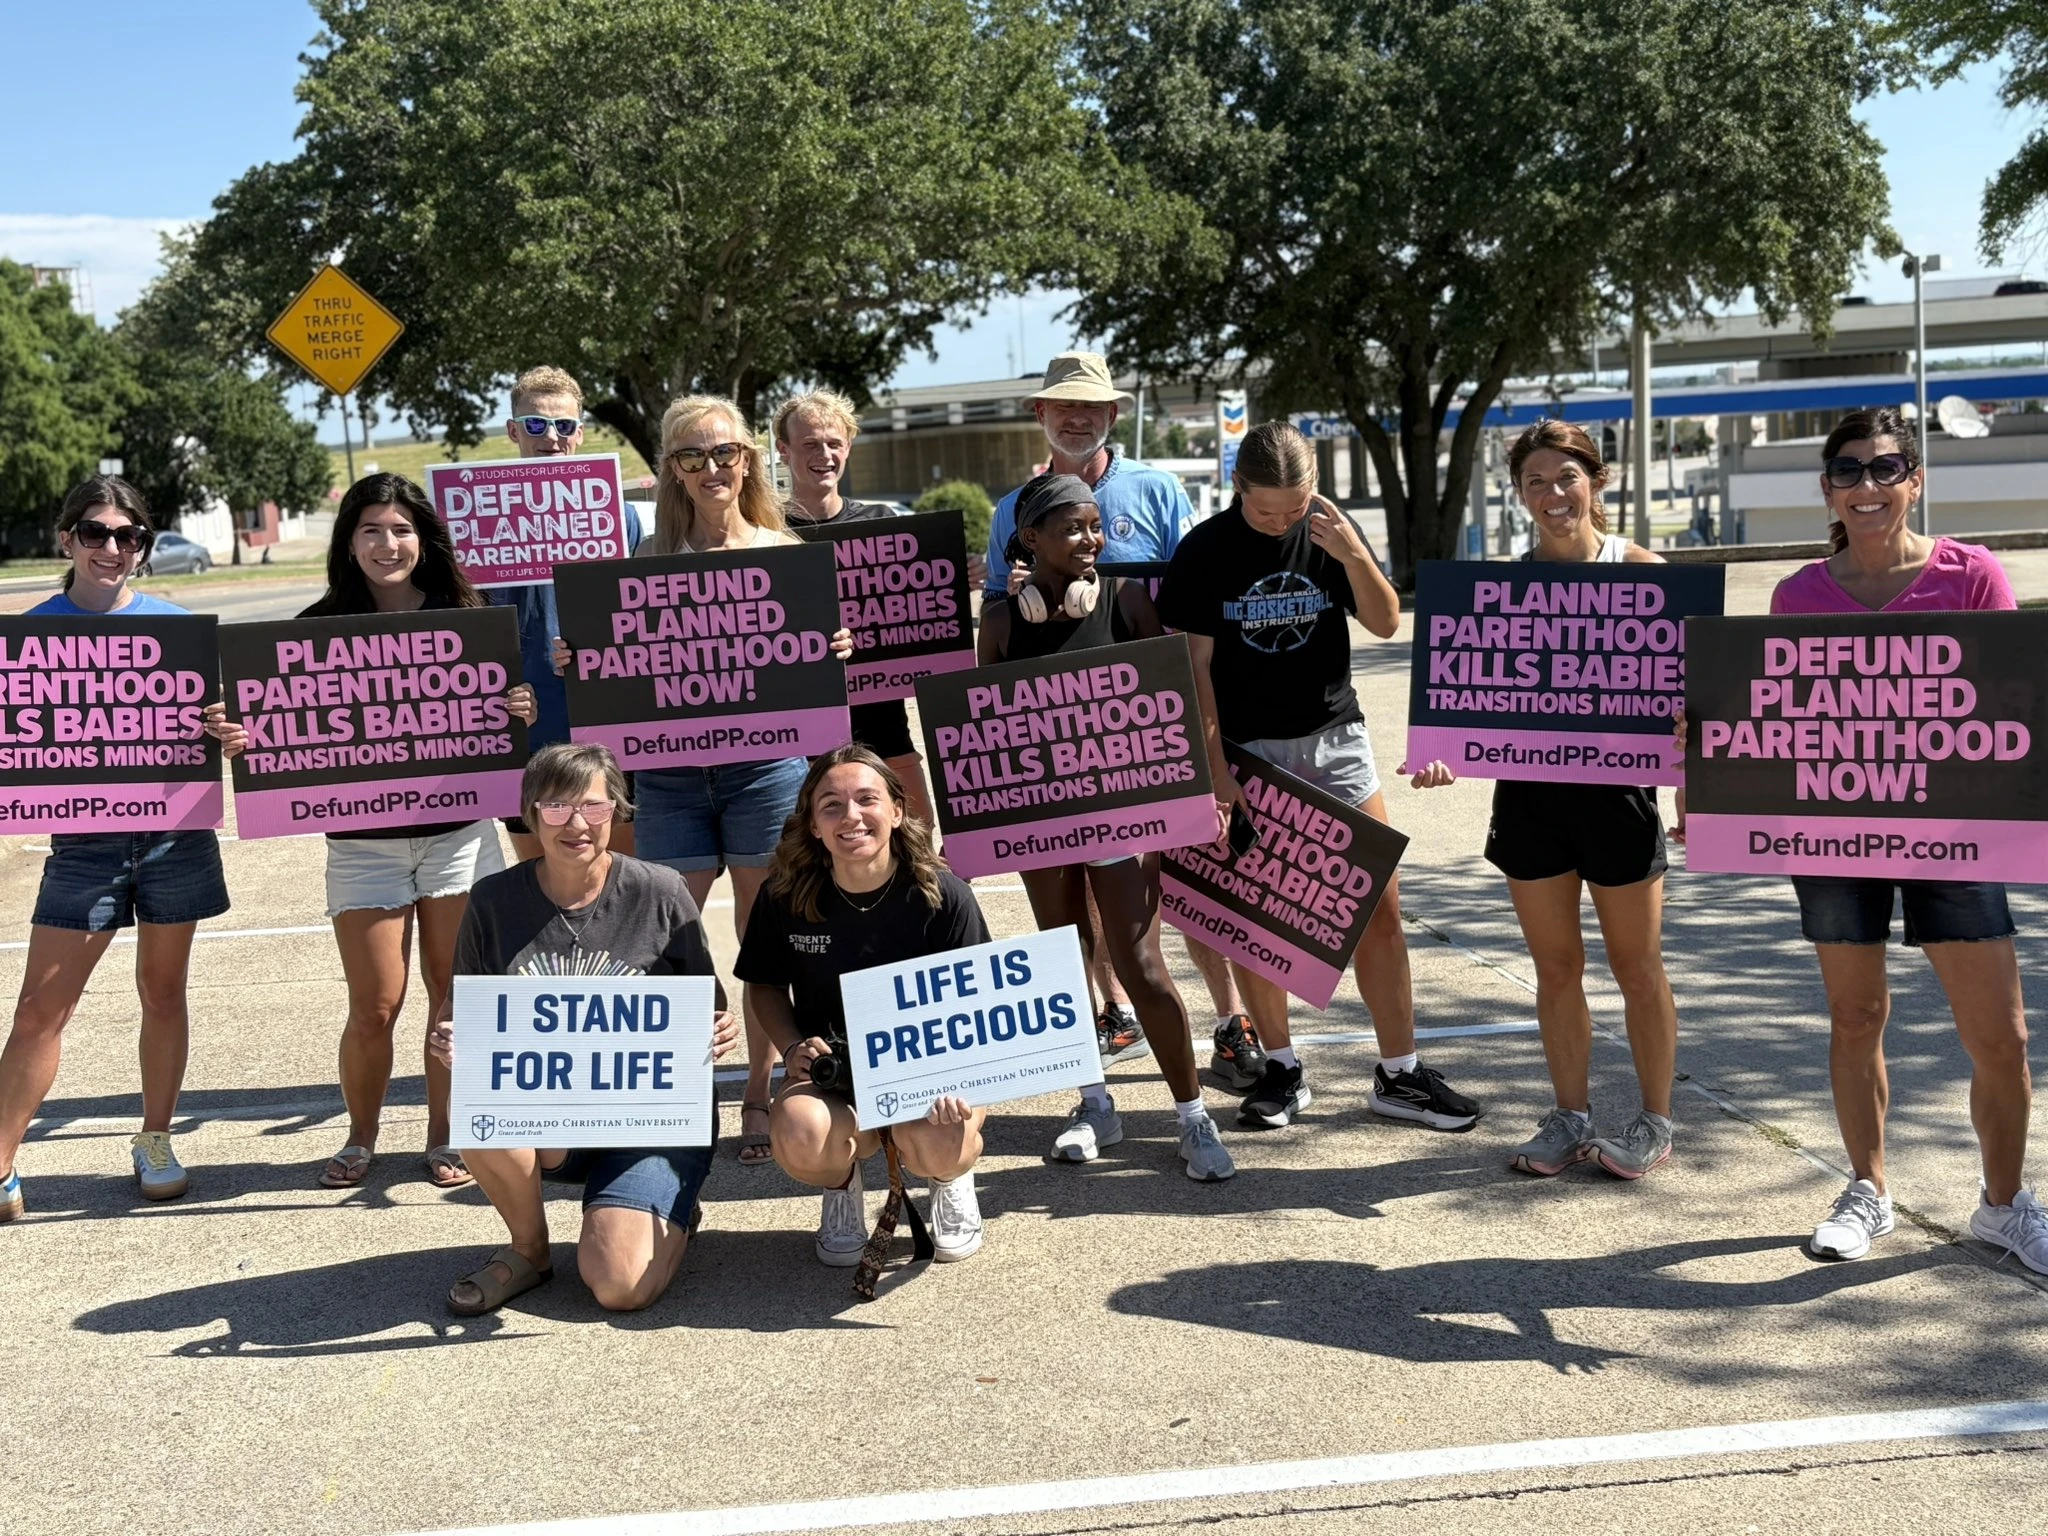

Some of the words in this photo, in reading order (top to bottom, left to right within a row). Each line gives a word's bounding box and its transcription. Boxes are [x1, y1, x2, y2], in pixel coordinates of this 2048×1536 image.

[304, 313, 365, 327] TRAFFIC
[313, 297, 352, 310] THRU
[307, 330, 364, 344] MERGE
[313, 347, 362, 360] RIGHT
[475, 464, 591, 480] STUDENTSFORLIFE.ORG
[444, 478, 612, 519] DEFUND
[448, 511, 615, 547] PLANNED
[455, 539, 617, 567] PARENTHOOD
[834, 532, 919, 568] NNED
[496, 569, 514, 578] TEXT
[517, 568, 534, 577] LIFE
[535, 567, 547, 575] TO
[619, 567, 772, 610] DEFUND
[837, 558, 955, 598] THOOD
[839, 588, 957, 629] BABIES
[1474, 581, 1665, 616] PLANNED
[612, 600, 786, 644] PLANNED
[880, 620, 960, 647] MINORS
[1242, 612, 1319, 630] INSTRUCTION
[1429, 615, 1685, 653] PARENTHOO
[0, 636, 162, 670] LANNED
[276, 630, 463, 674] PLANNED
[577, 630, 827, 681] PARENTHOOD
[1429, 651, 1541, 687] KILLS
[1551, 655, 1685, 691] BABIE
[1764, 635, 1962, 676] DEFUND
[0, 670, 206, 705] ENTHOOD
[236, 662, 507, 712] PARENTHOOD
[654, 669, 757, 708] NOW!
[847, 670, 932, 693] dPP.co
[967, 662, 1140, 719] PLANNED
[1750, 677, 1977, 718] PLANNED
[242, 708, 355, 750] KILLS
[363, 696, 510, 740] BABIES
[1426, 689, 1594, 716] TRANSITIONS
[1600, 695, 1685, 718] MINO
[54, 706, 205, 743] BABIES
[624, 727, 799, 756] DefundPP.com
[935, 690, 1185, 758] PARENTHOOD
[1701, 720, 2031, 762] PARENTHOOD
[0, 746, 99, 769] SITIONS
[105, 744, 207, 767] MINORS
[244, 741, 410, 775] TRANSITIONS
[414, 733, 513, 761] MINORS
[943, 748, 1045, 793] KILLS
[1050, 724, 1190, 777] BABIES
[1465, 741, 1660, 770] DefundPP.com
[947, 776, 1097, 817] TRANSITIONS
[1101, 760, 1196, 793] MINORS
[1796, 762, 1928, 803] NOW!
[0, 797, 167, 820] efundPP.com
[291, 790, 478, 821] DefundPP.com
[1229, 764, 1353, 851] ANNED
[993, 818, 1167, 859] DefundPP.com
[1247, 806, 1373, 898] THOOD
[1749, 831, 1978, 861] DefundPP.com
[1160, 848, 1262, 906] NSITIONS
[1261, 893, 1347, 951] MINORS
[1234, 847, 1359, 929] BABIES
[806, 944, 828, 953] LIFE
[1160, 885, 1292, 975] efundPP.com
[893, 959, 977, 1011] LIFE
[990, 949, 1032, 990] IS
[497, 994, 508, 1033] I
[533, 993, 670, 1033] STAND
[865, 992, 1076, 1069] PRECIOUS
[491, 1051, 573, 1091] FOR
[590, 1051, 674, 1091] LIFE
[901, 1084, 957, 1102] COLORADO
[961, 1072, 1016, 1089] CHRISTIAN
[1020, 1059, 1081, 1077] UNIVERSITY
[498, 1118, 559, 1128] COLORADO
[562, 1118, 622, 1128] CHRISTIAN
[626, 1117, 691, 1127] UNIVERSITY
